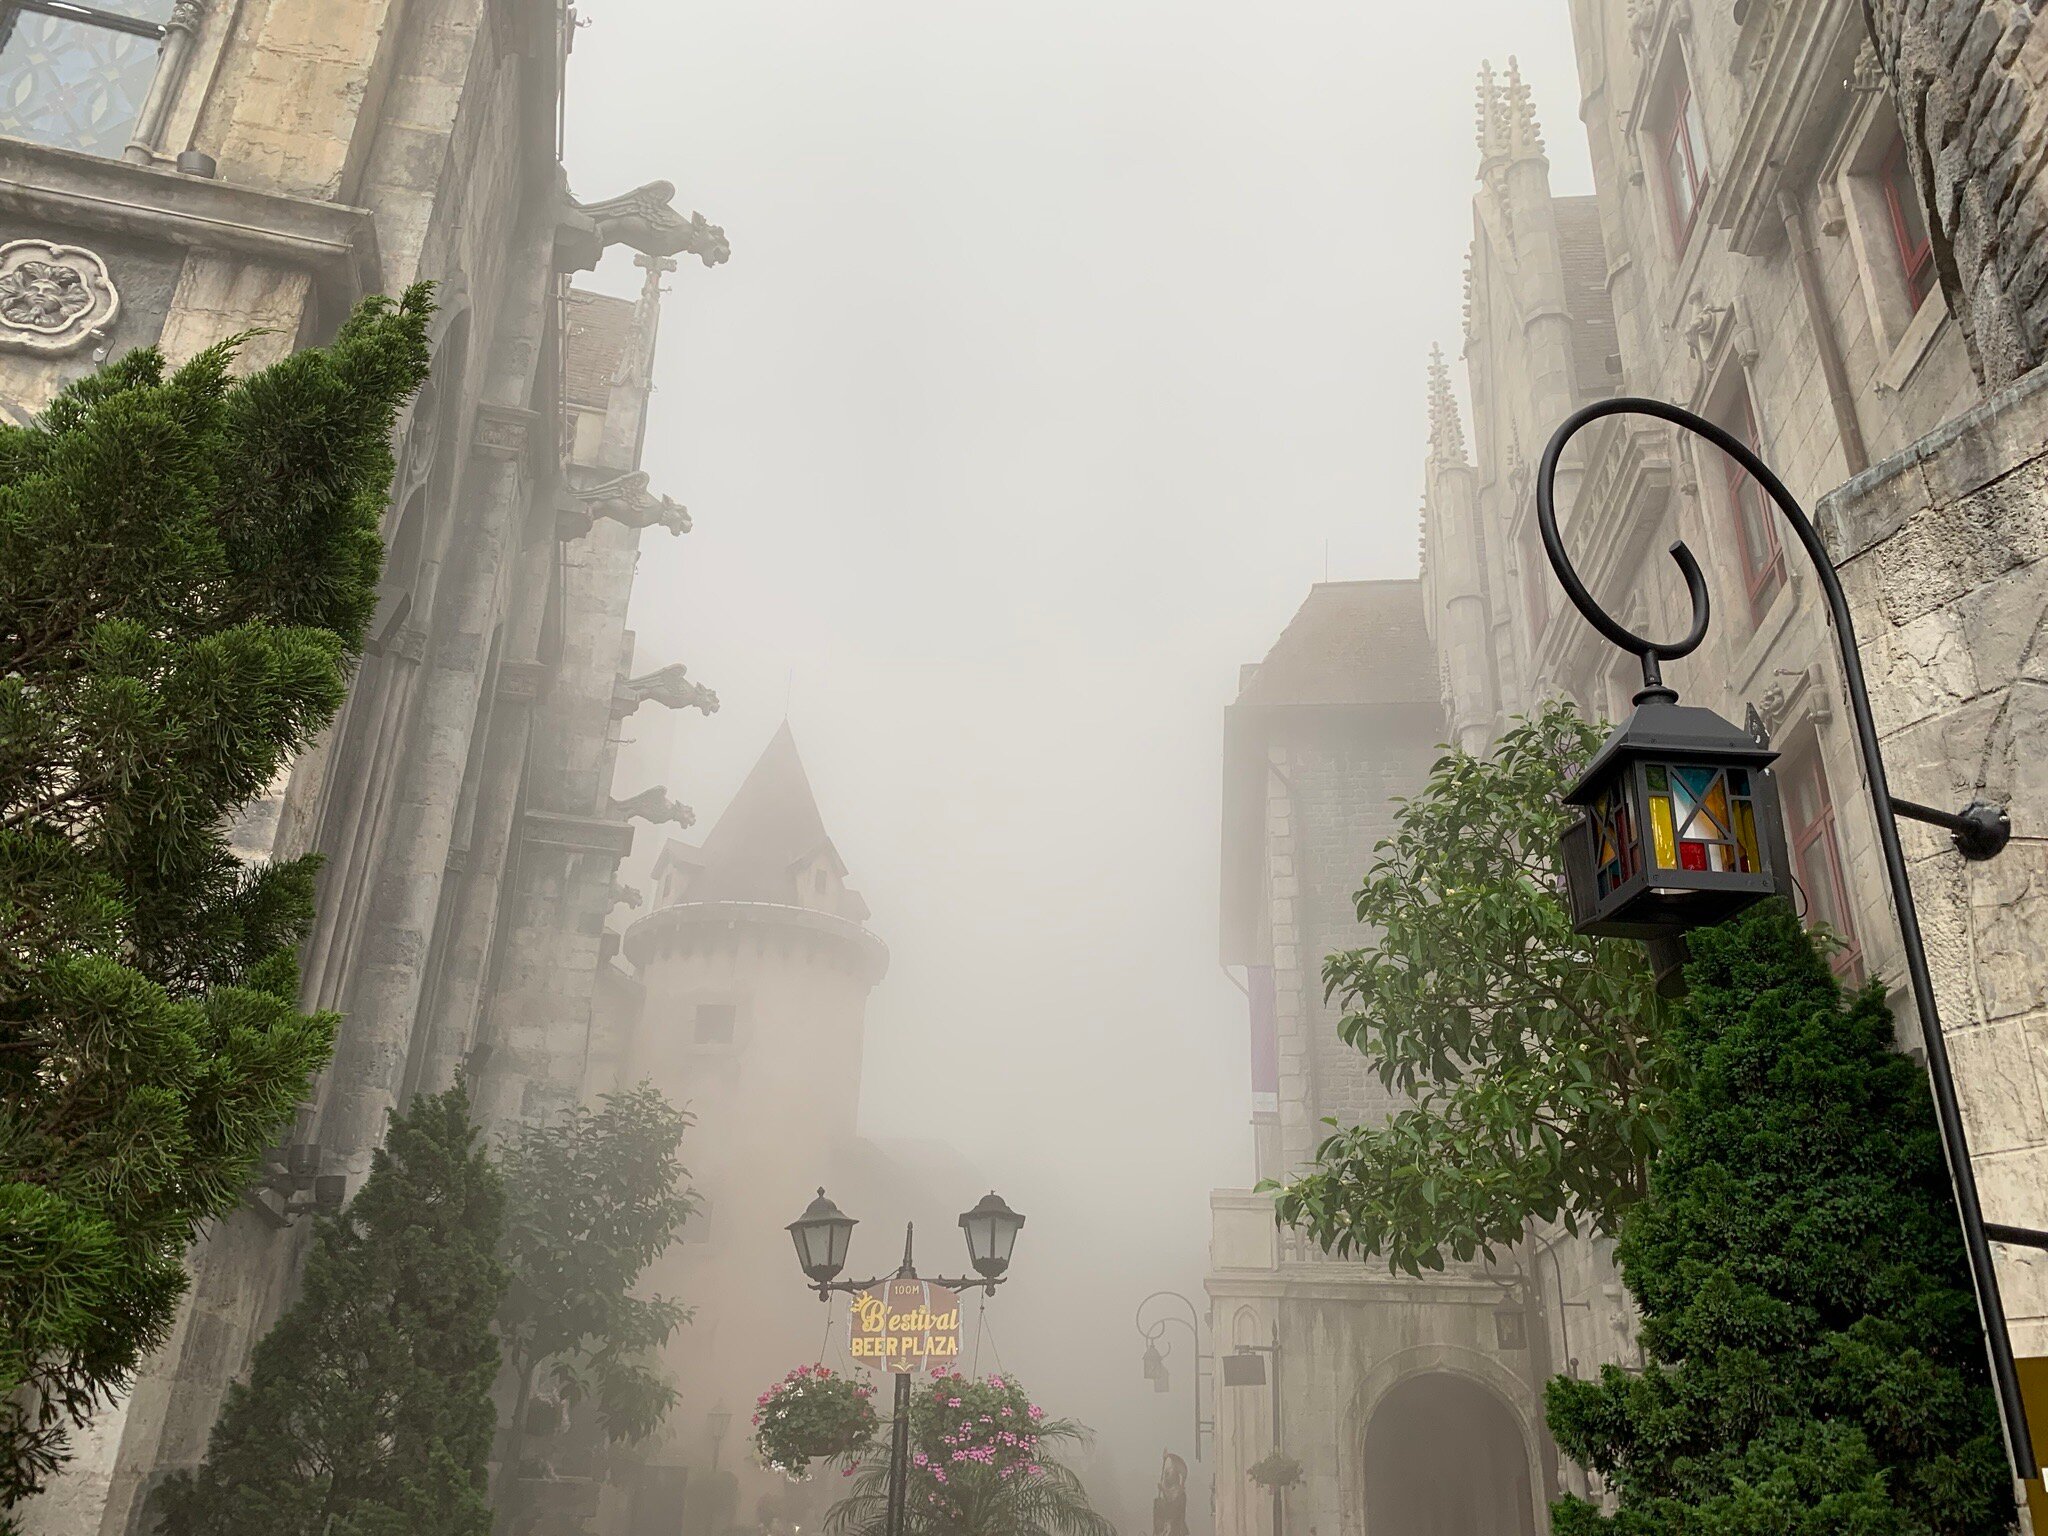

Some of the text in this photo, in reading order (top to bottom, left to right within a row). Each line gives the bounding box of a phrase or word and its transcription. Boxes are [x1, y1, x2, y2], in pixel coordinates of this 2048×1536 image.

[894, 1285, 920, 1295] 100M
[860, 1299, 960, 1332] B'estival
[852, 1336, 958, 1357] BEER PLAZA
